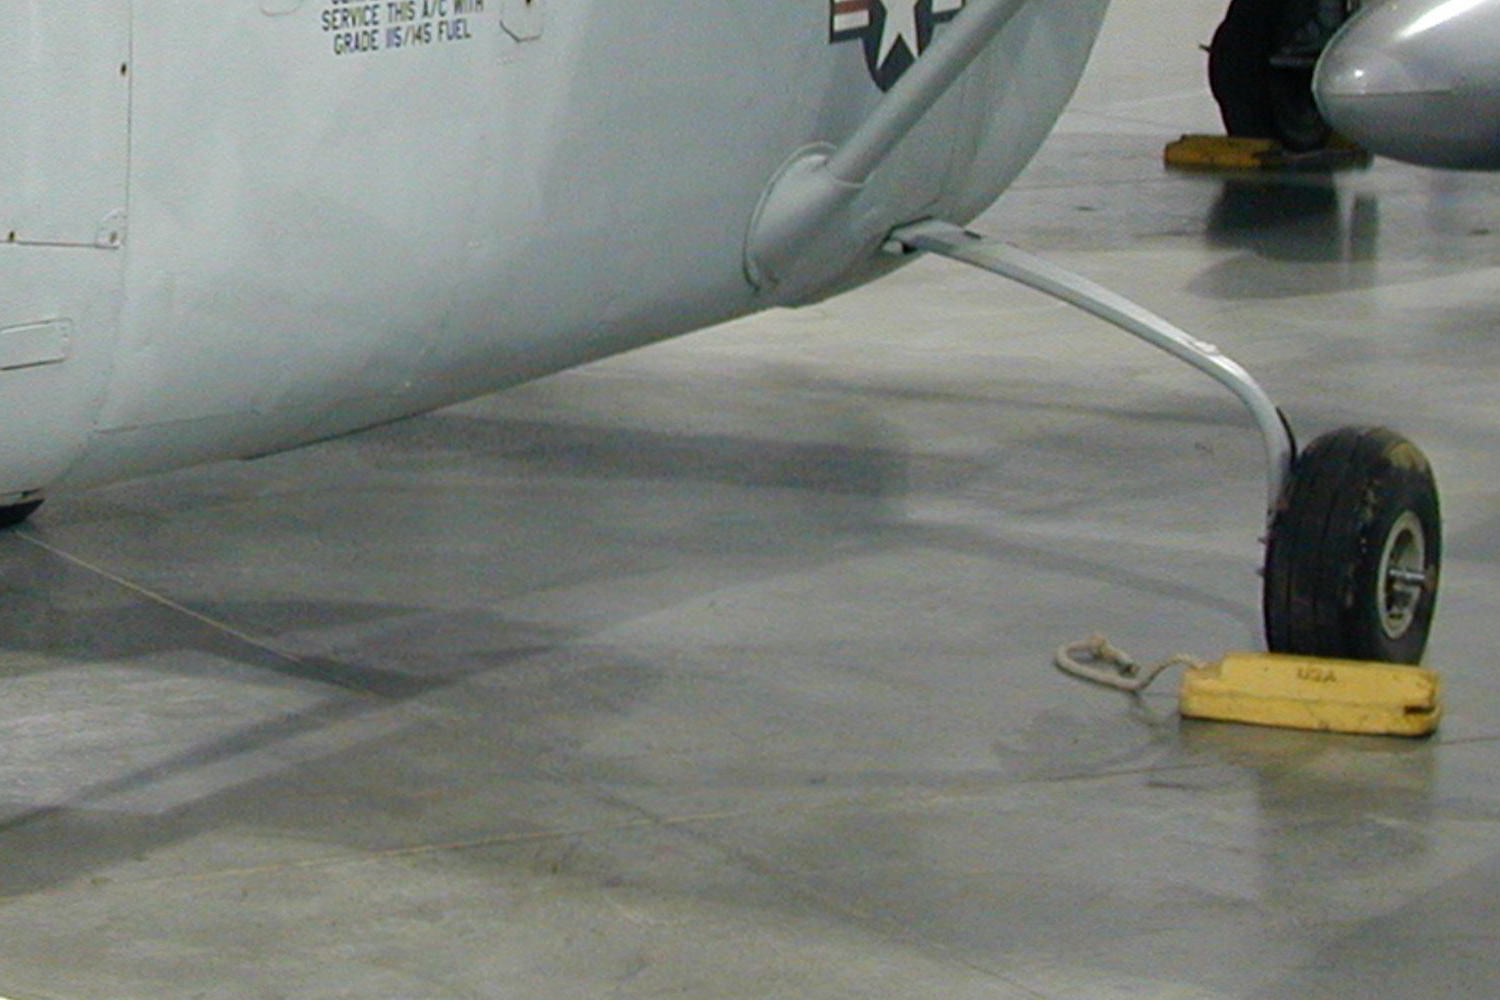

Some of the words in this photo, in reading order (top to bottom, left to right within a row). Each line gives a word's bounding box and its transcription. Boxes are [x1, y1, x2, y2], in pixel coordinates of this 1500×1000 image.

[321, 5, 380, 31] SERVICE
[387, 0, 415, 23] THIS
[333, 30, 380, 55] GRADE
[438, 19, 472, 42] FUEL
